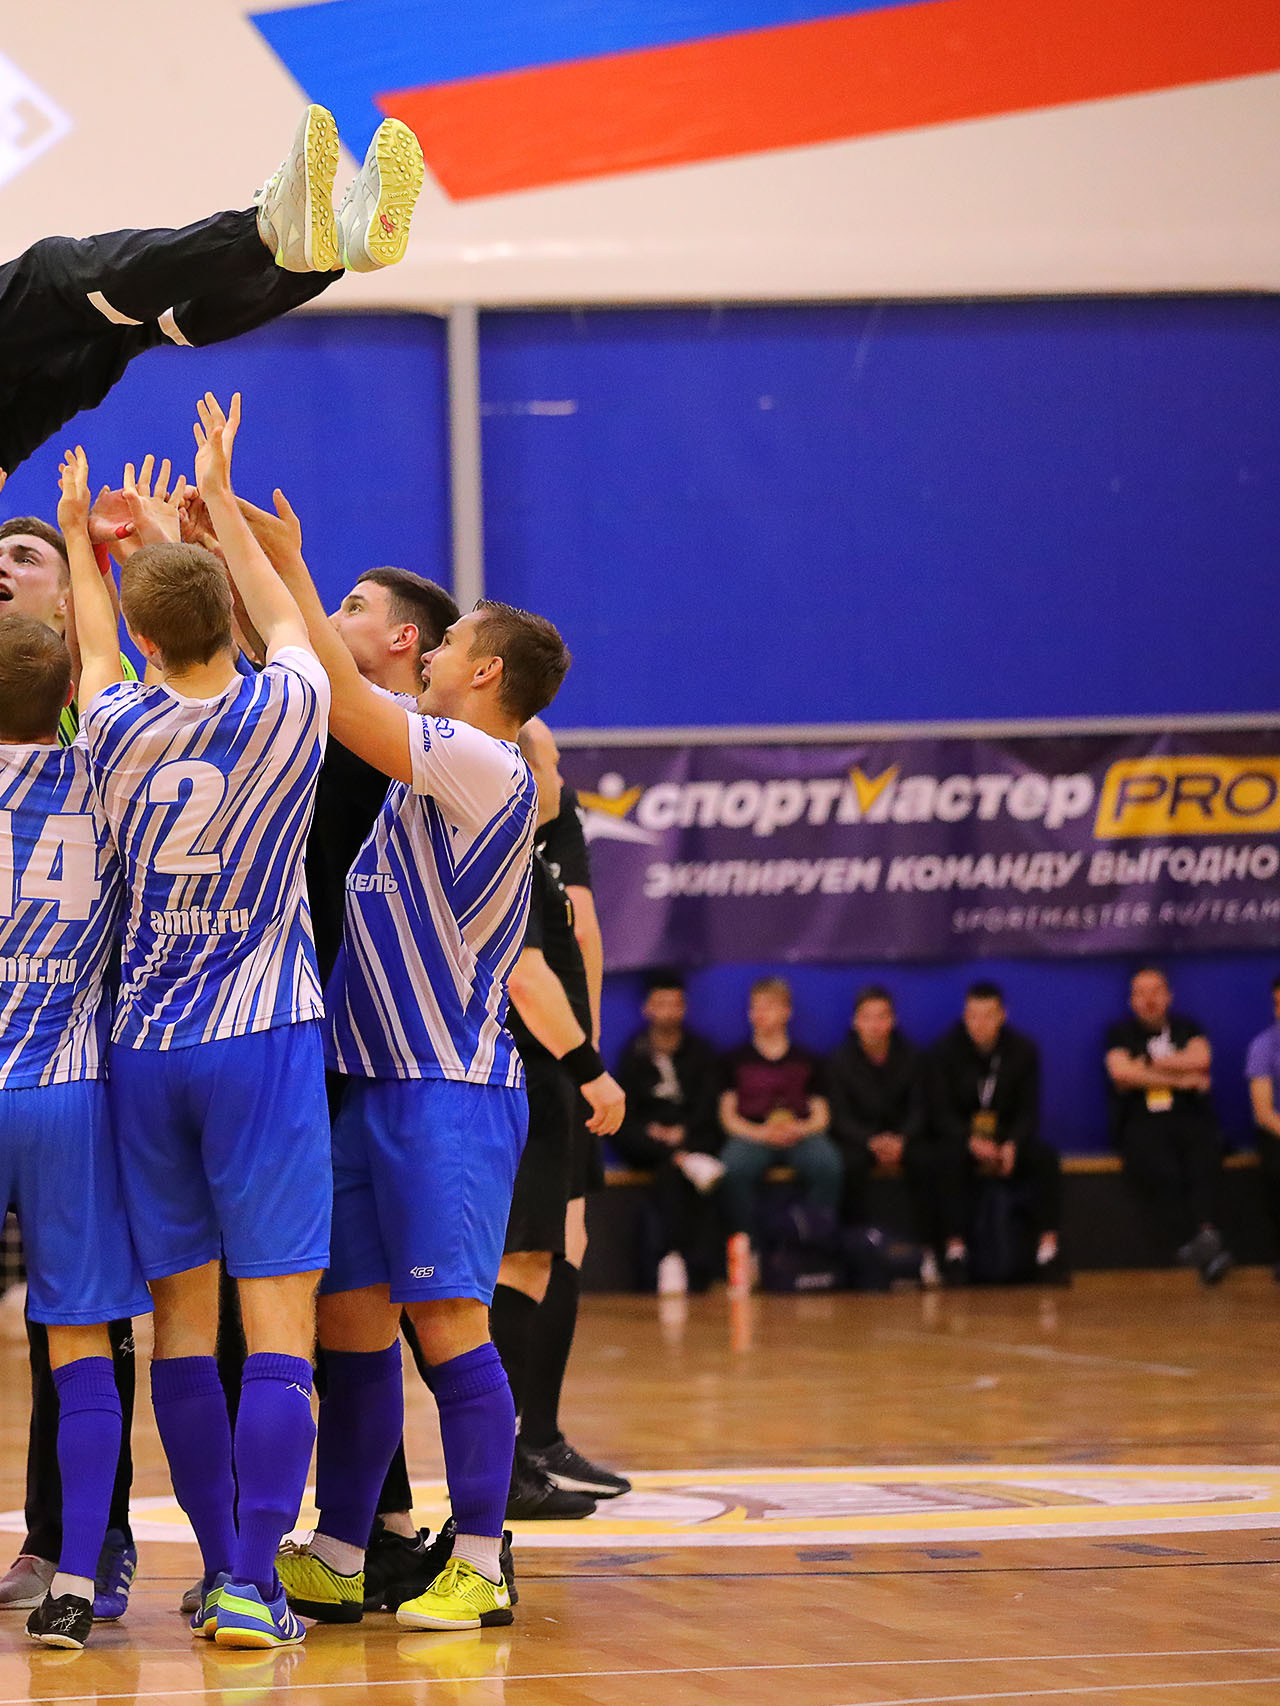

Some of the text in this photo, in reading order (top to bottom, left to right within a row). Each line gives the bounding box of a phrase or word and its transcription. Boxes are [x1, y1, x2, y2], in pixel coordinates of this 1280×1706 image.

[147, 757, 229, 876] 2
[1114, 771, 1278, 822] PRO
[643, 844, 1279, 899] ЭКИПИРУЕМ КОМАНДУ ВЫГОДНО
[149, 906, 251, 936] amfr.ru
